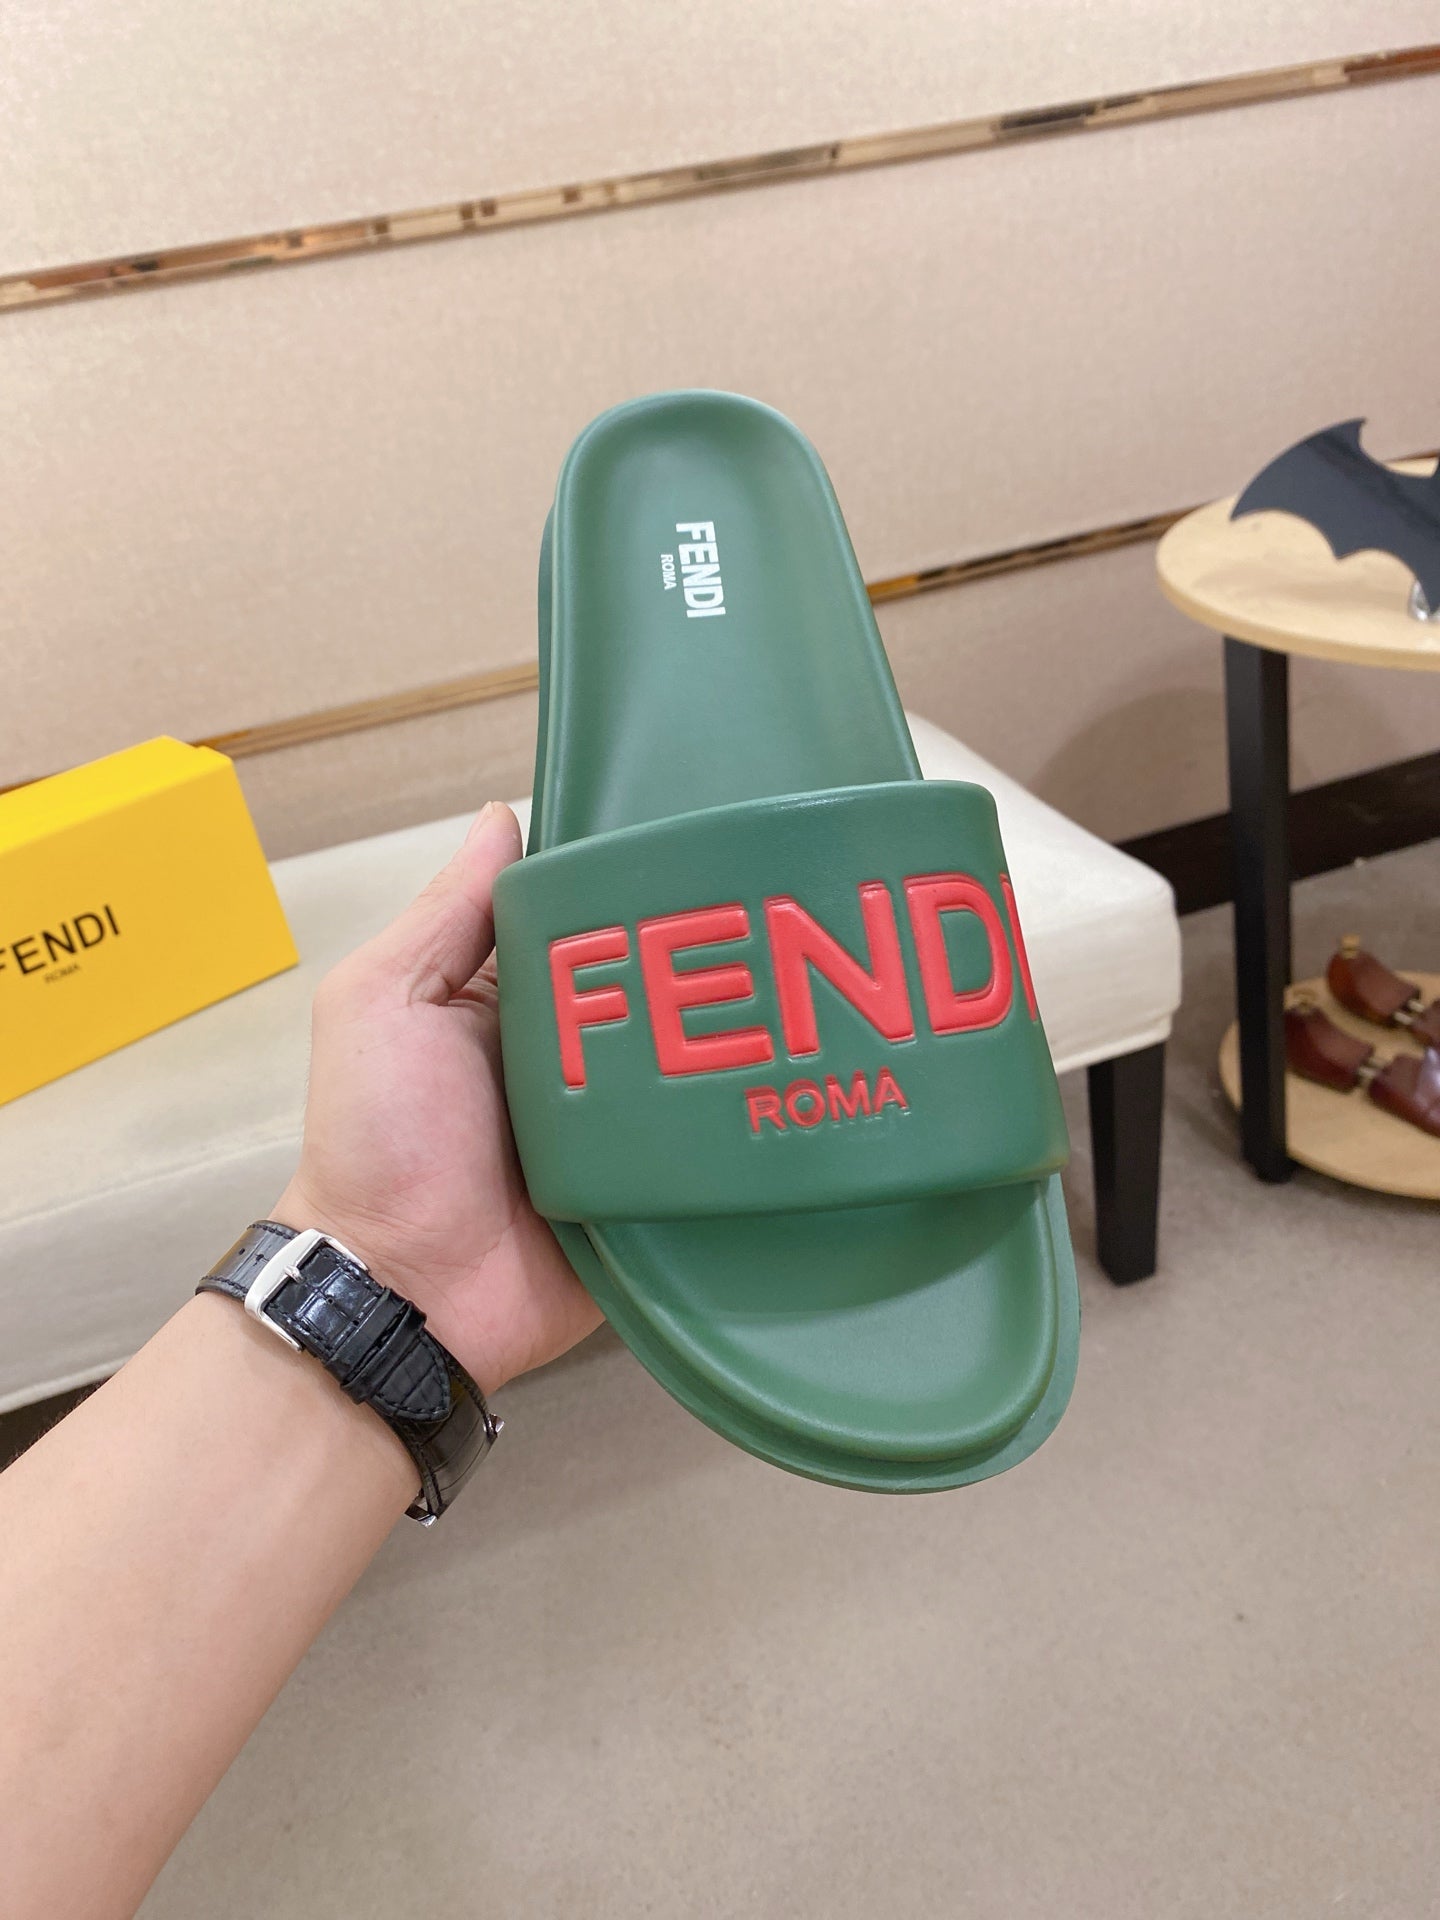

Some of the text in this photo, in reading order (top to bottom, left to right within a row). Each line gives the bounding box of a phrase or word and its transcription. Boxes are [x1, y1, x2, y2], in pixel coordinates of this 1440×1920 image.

[660, 554, 677, 590] ROMA
[675, 521, 726, 618] FENDI
[0, 904, 119, 975] ENDI
[745, 1066, 909, 1134] ROMA
